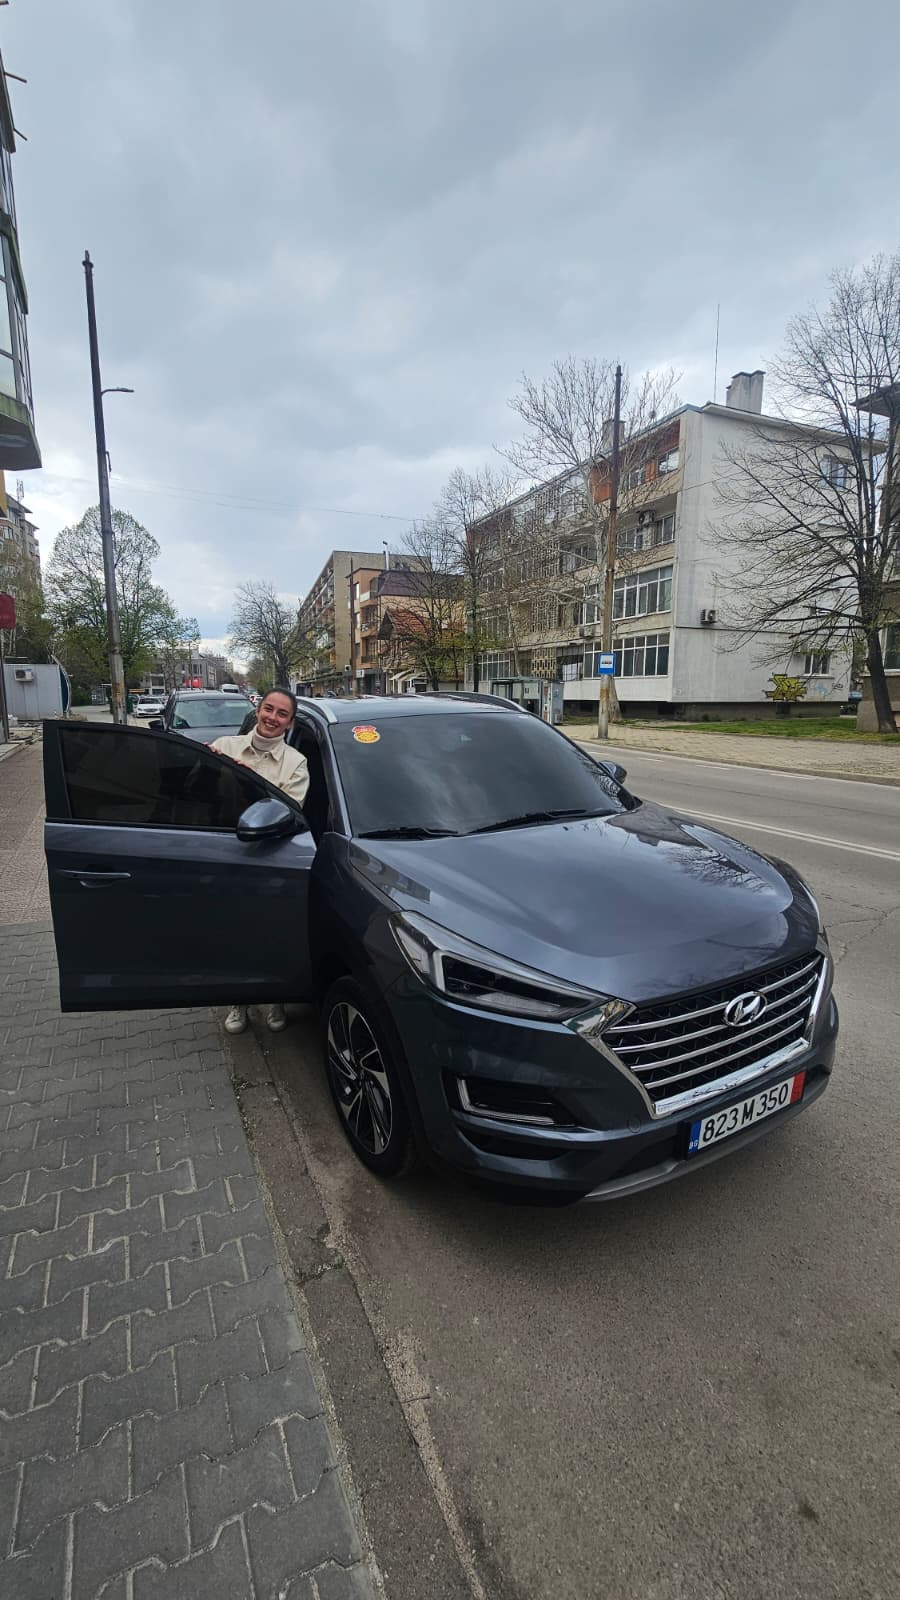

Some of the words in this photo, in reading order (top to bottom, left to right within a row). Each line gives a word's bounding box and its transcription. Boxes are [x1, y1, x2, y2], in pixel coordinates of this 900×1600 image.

[702, 1107, 739, 1142] 823
[741, 1099, 755, 1125] M
[756, 1083, 788, 1116] 350
